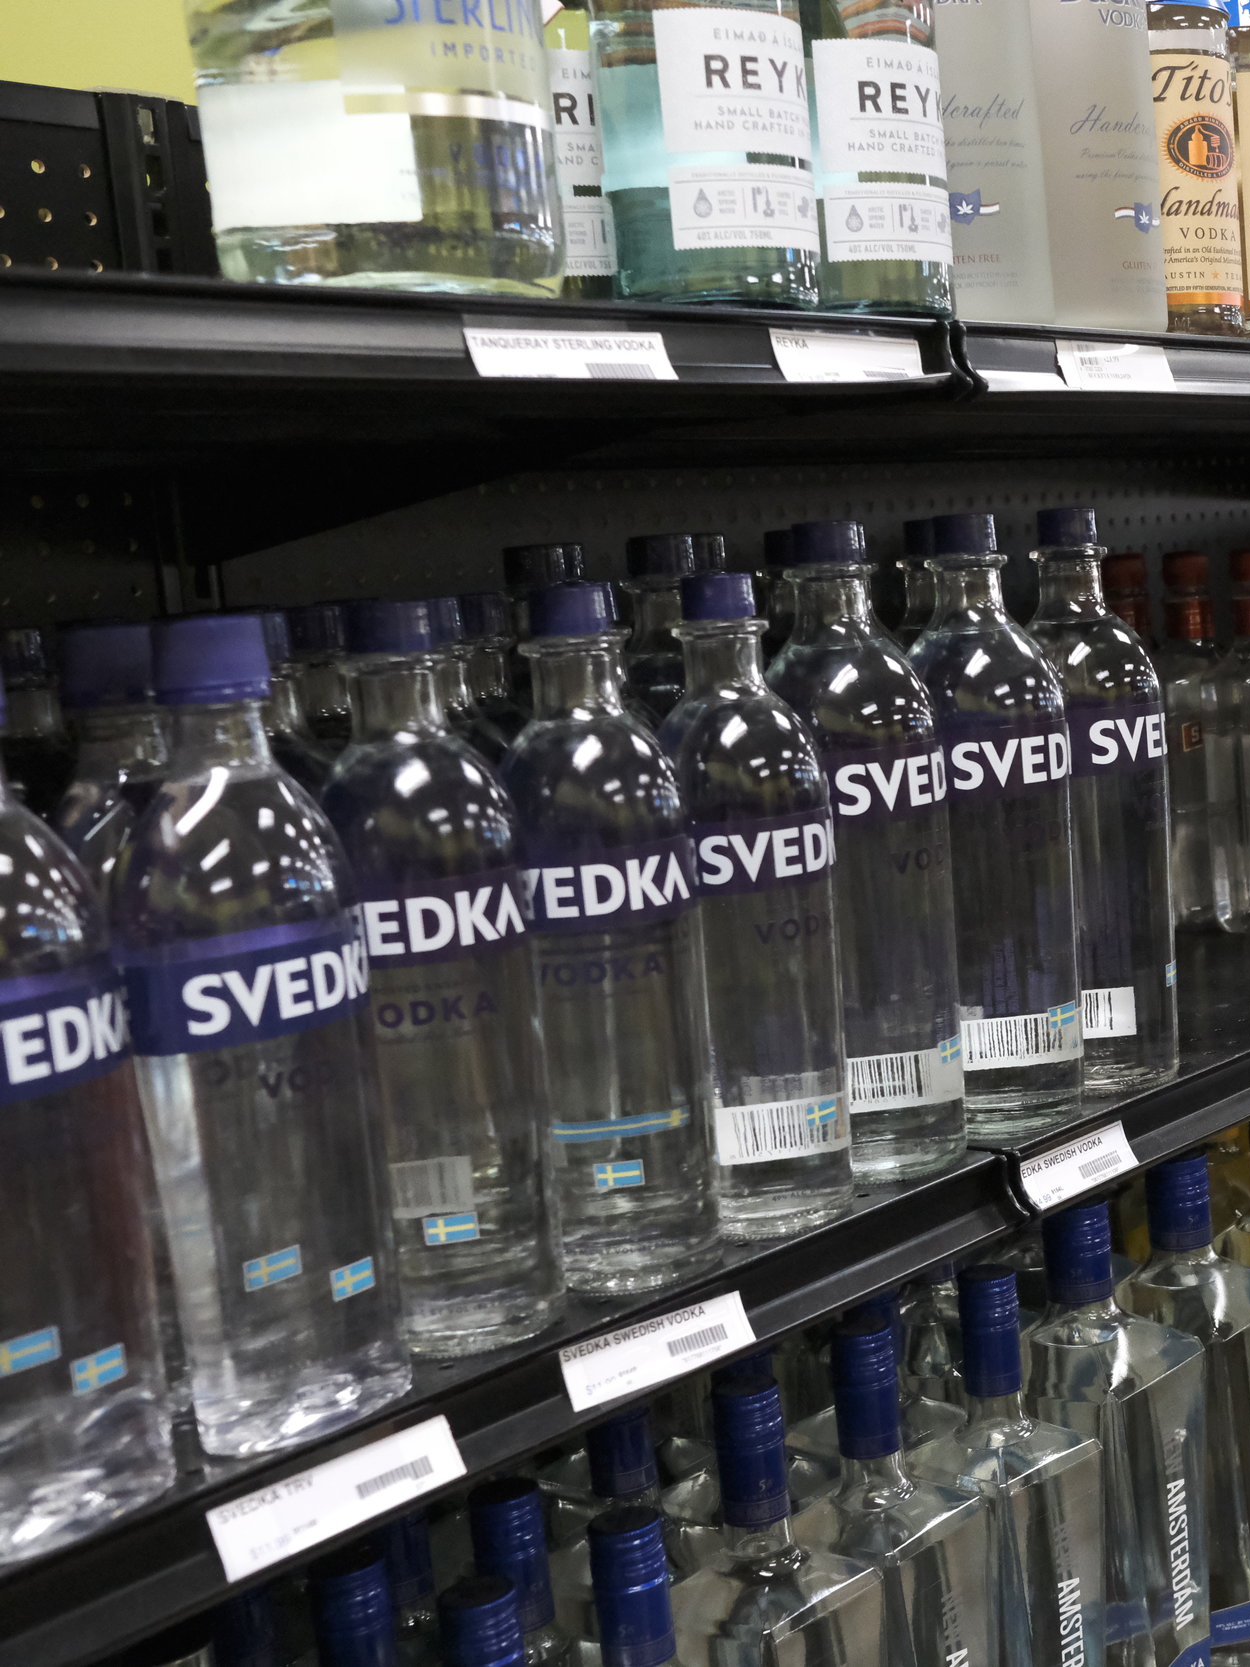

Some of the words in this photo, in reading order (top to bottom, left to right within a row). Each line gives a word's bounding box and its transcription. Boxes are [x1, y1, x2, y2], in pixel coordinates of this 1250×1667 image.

[718, 106, 763, 118] SMALL
[694, 120, 735, 131] HAND
[869, 128, 909, 140] SMALL
[848, 142, 884, 152] HAND
[1179, 227, 1236, 242] VODKA
[472, 335, 550, 350] TANQUERAY
[553, 338, 612, 350] STERLING
[613, 340, 657, 351] VODKA
[776, 336, 808, 350] REYKA
[1043, 1148, 1077, 1169] SWEDISH
[1077, 1136, 1103, 1154] VODKA
[562, 1336, 612, 1363] SVEDKA
[612, 1317, 665, 1346] SWEDISH
[666, 1304, 706, 1328] VODKA
[1166, 1478, 1195, 1632] AMSTERDAM
